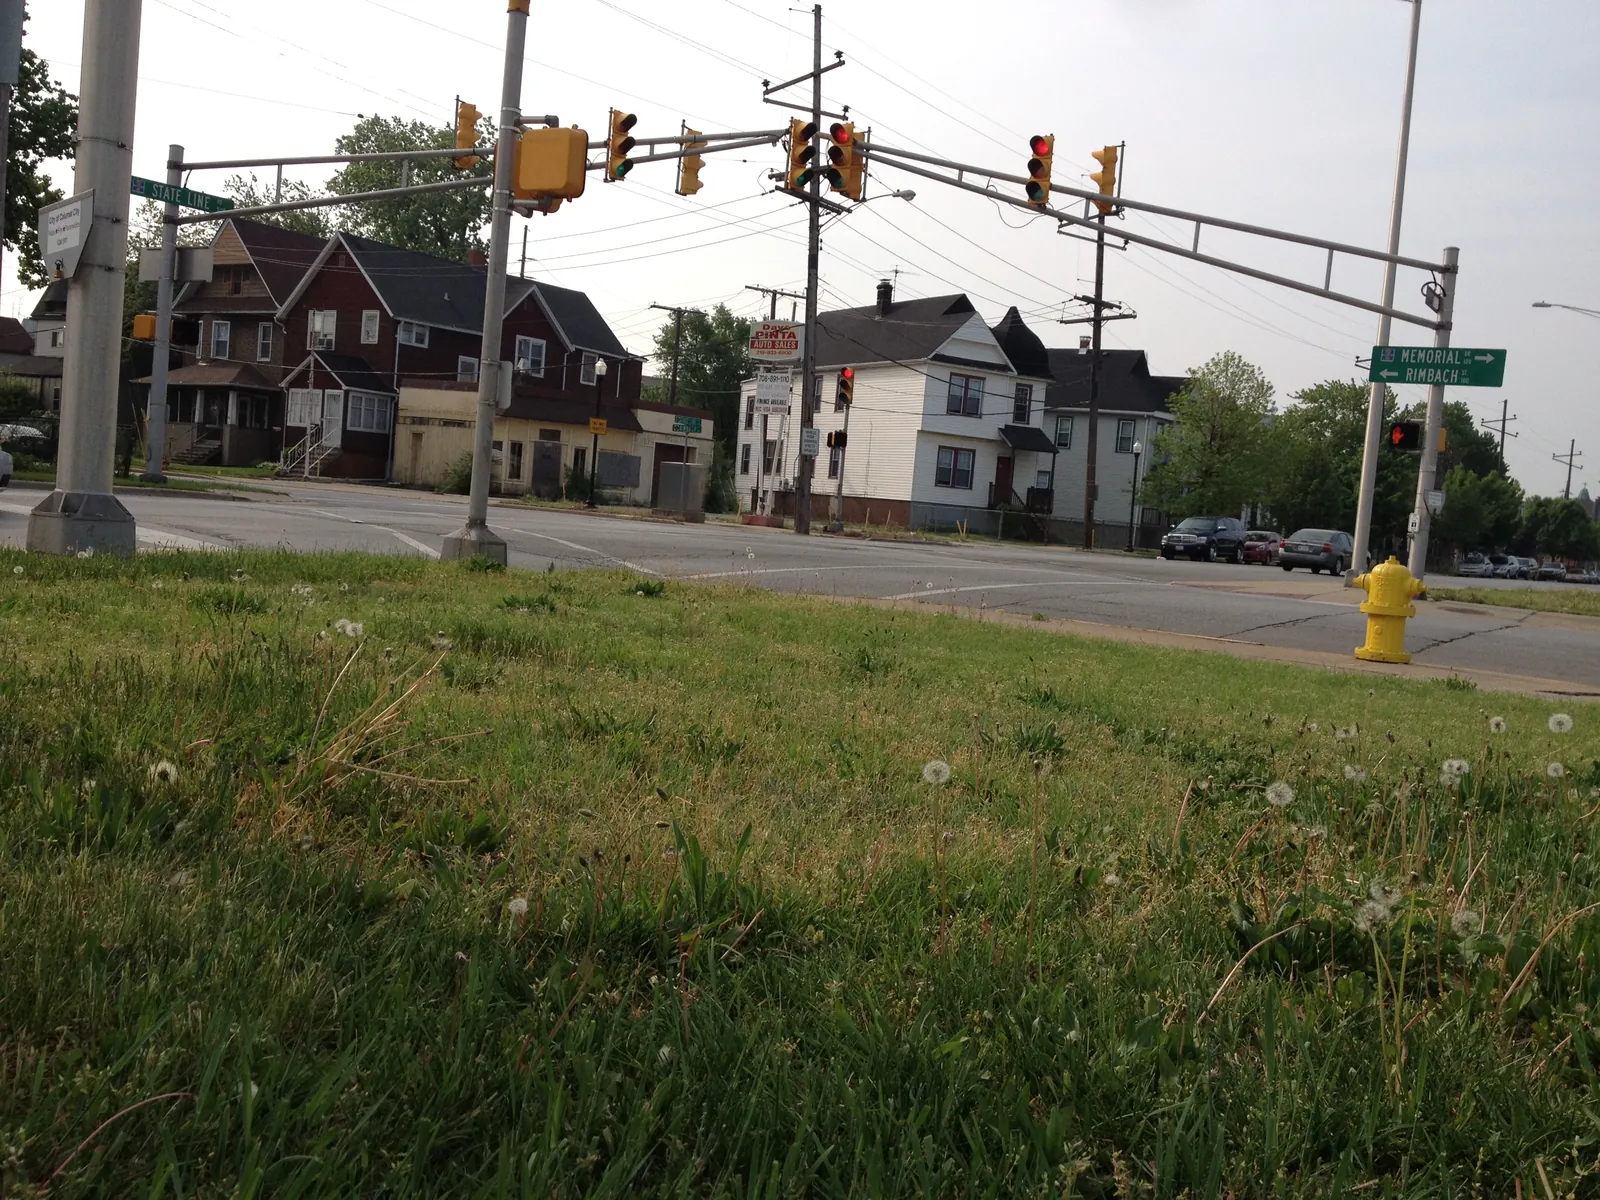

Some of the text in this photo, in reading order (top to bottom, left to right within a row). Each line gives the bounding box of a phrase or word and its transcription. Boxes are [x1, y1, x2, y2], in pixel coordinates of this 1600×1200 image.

[152, 183, 211, 210] STATE LINE
[755, 331, 797, 339] PINTA
[753, 340, 796, 349] AUTO SALES
[1400, 348, 1461, 365] MEMORIAL
[1405, 367, 1459, 383] RIMBACH
